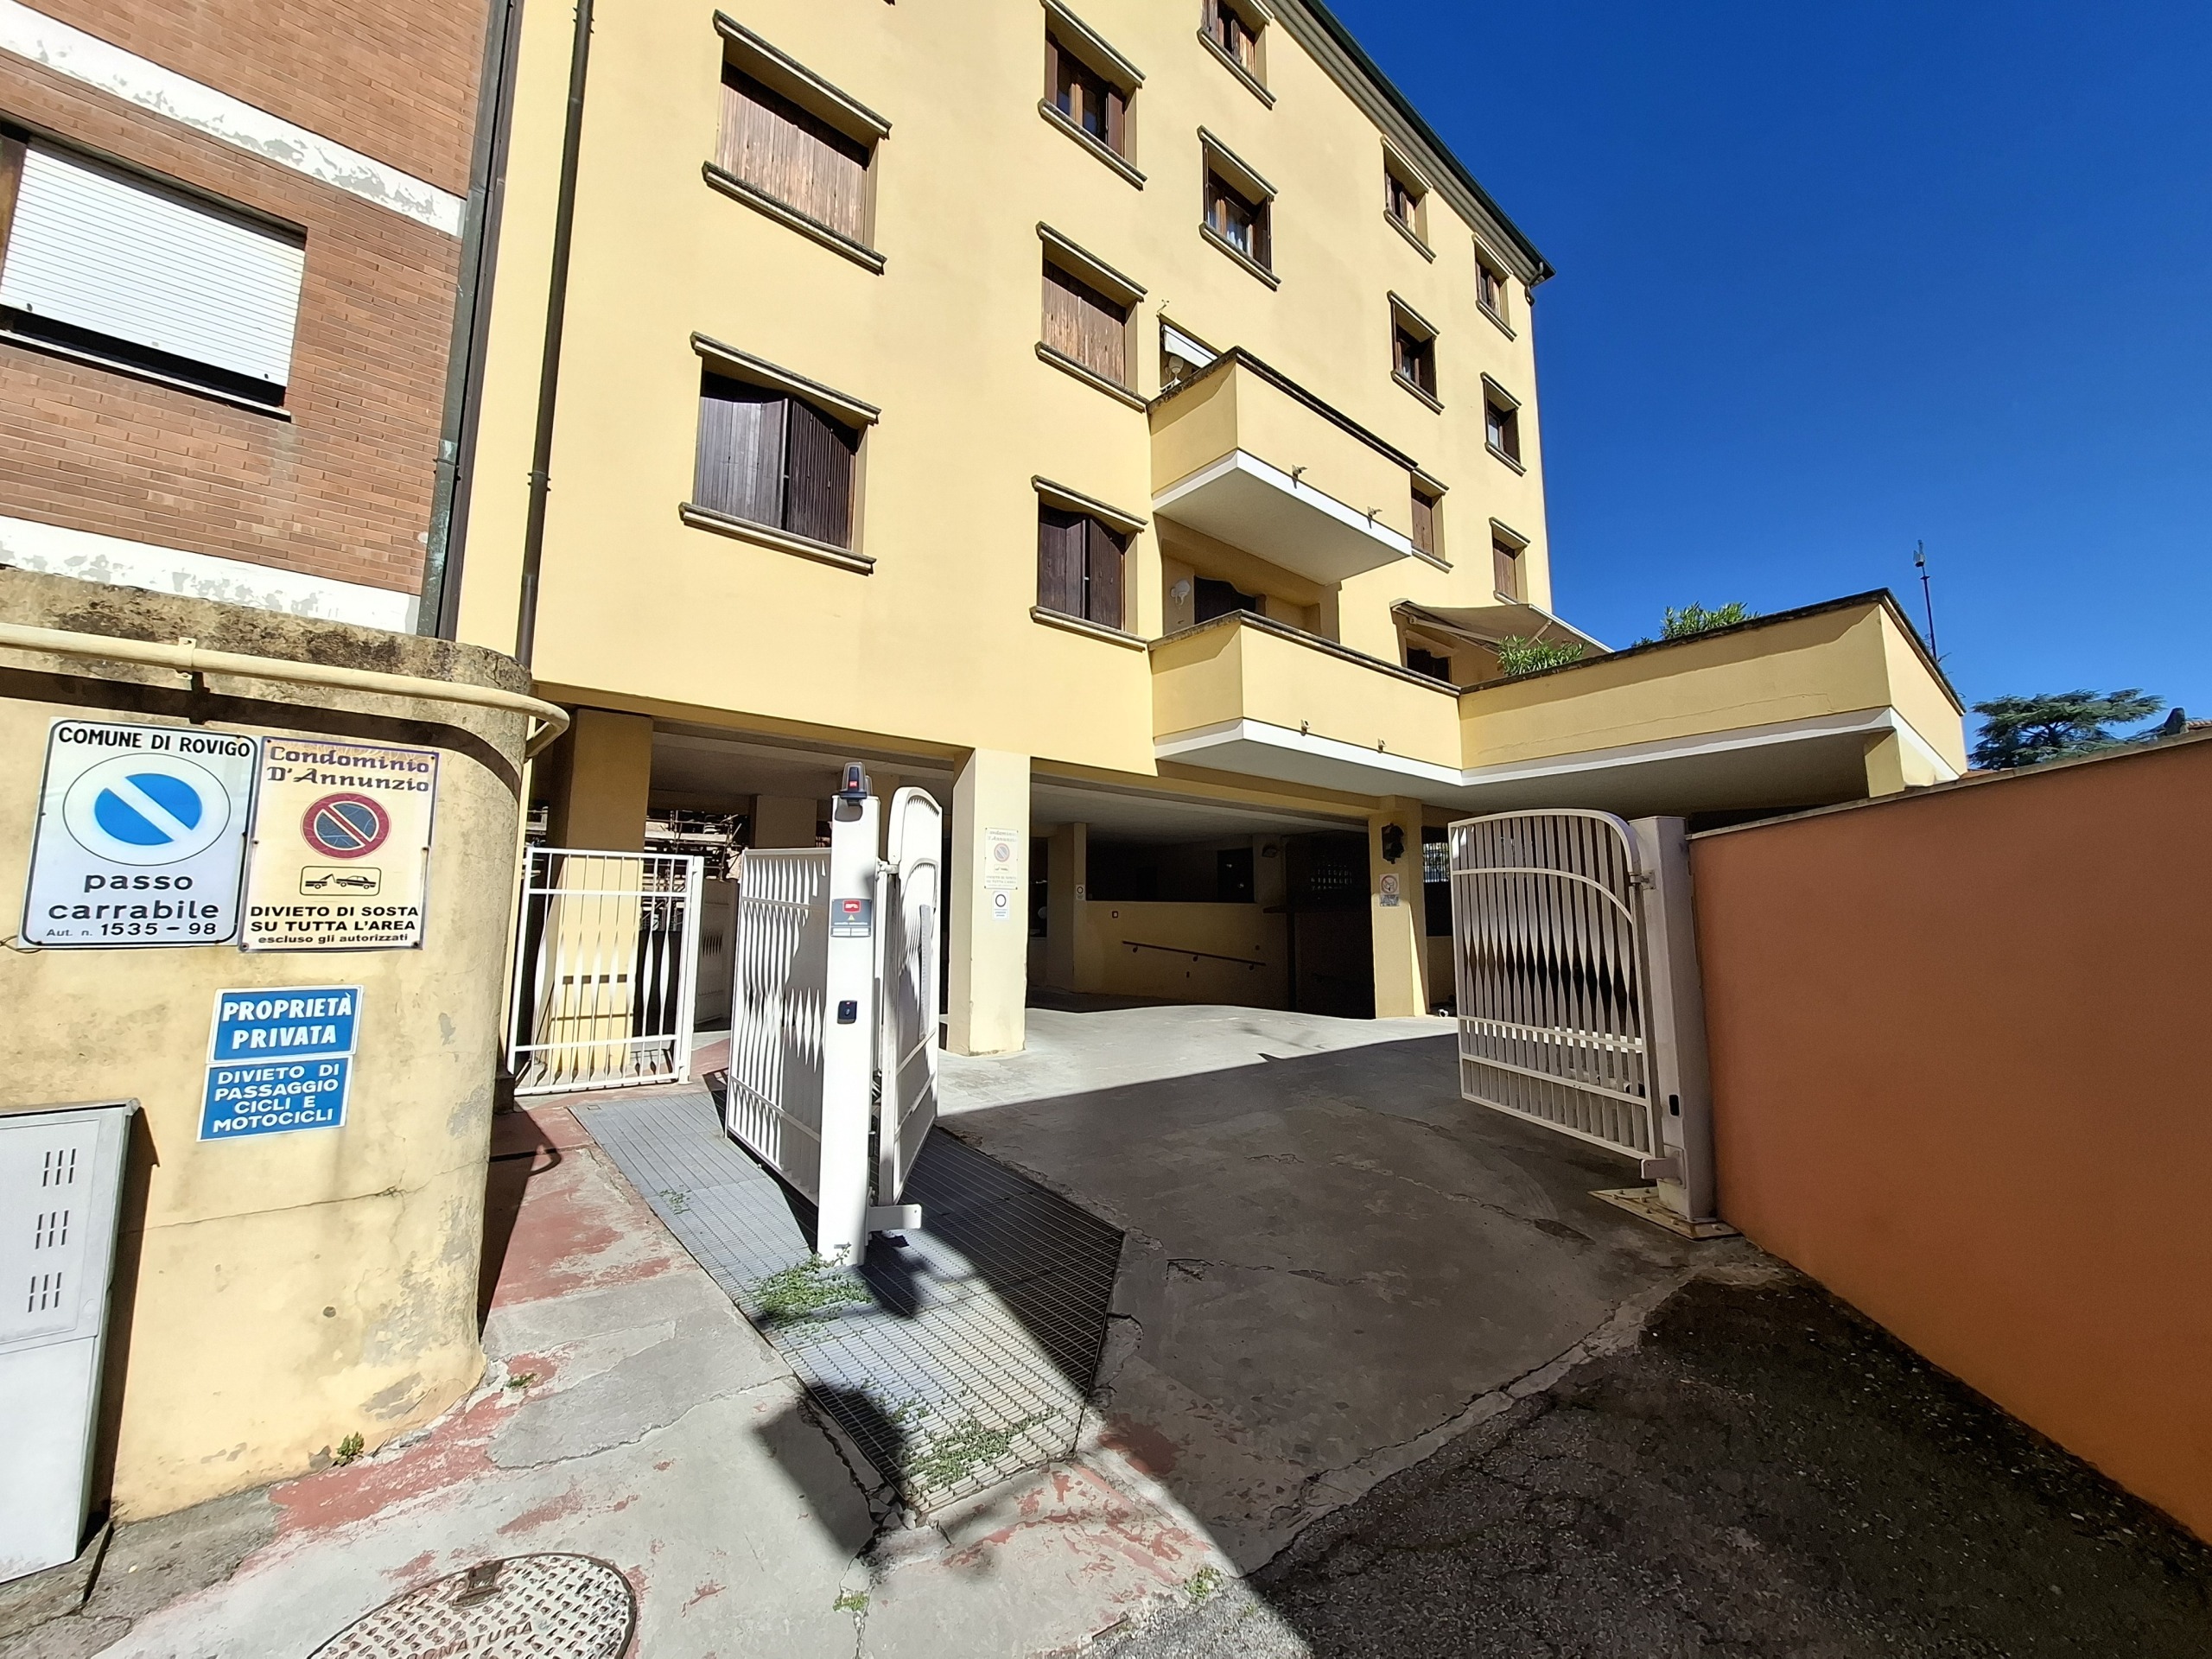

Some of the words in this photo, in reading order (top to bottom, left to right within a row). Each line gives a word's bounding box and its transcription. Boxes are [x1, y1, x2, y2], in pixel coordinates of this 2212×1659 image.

[59, 727, 142, 748] COMUNE
[151, 734, 170, 750] DI
[180, 737, 250, 757] ROVIGO
[270, 746, 429, 773] Condominio
[267, 766, 429, 791] D'Annunzio
[84, 874, 193, 893] passo
[48, 899, 219, 919] carrabile
[251, 906, 330, 917] DIVIETO
[337, 907, 354, 916] DI
[361, 906, 418, 916] SOSTA
[101, 923, 158, 936] 1535
[188, 923, 216, 935] 98
[251, 921, 277, 931] SU
[285, 921, 347, 931] TUTTA
[354, 920, 415, 931] L'AREA
[318, 935, 334, 944] gli
[340, 934, 408, 943] autorizzati
[222, 992, 352, 1021] PROPRIETÀ
[232, 1025, 336, 1050] PRIVATA
[218, 1065, 305, 1084] DIVIETO
[319, 1064, 340, 1077] DI
[214, 1078, 338, 1102] PASSAGGIO
[234, 1097, 290, 1114] CICLI
[303, 1096, 315, 1108] E
[213, 1109, 333, 1133] MOTOCICLI
